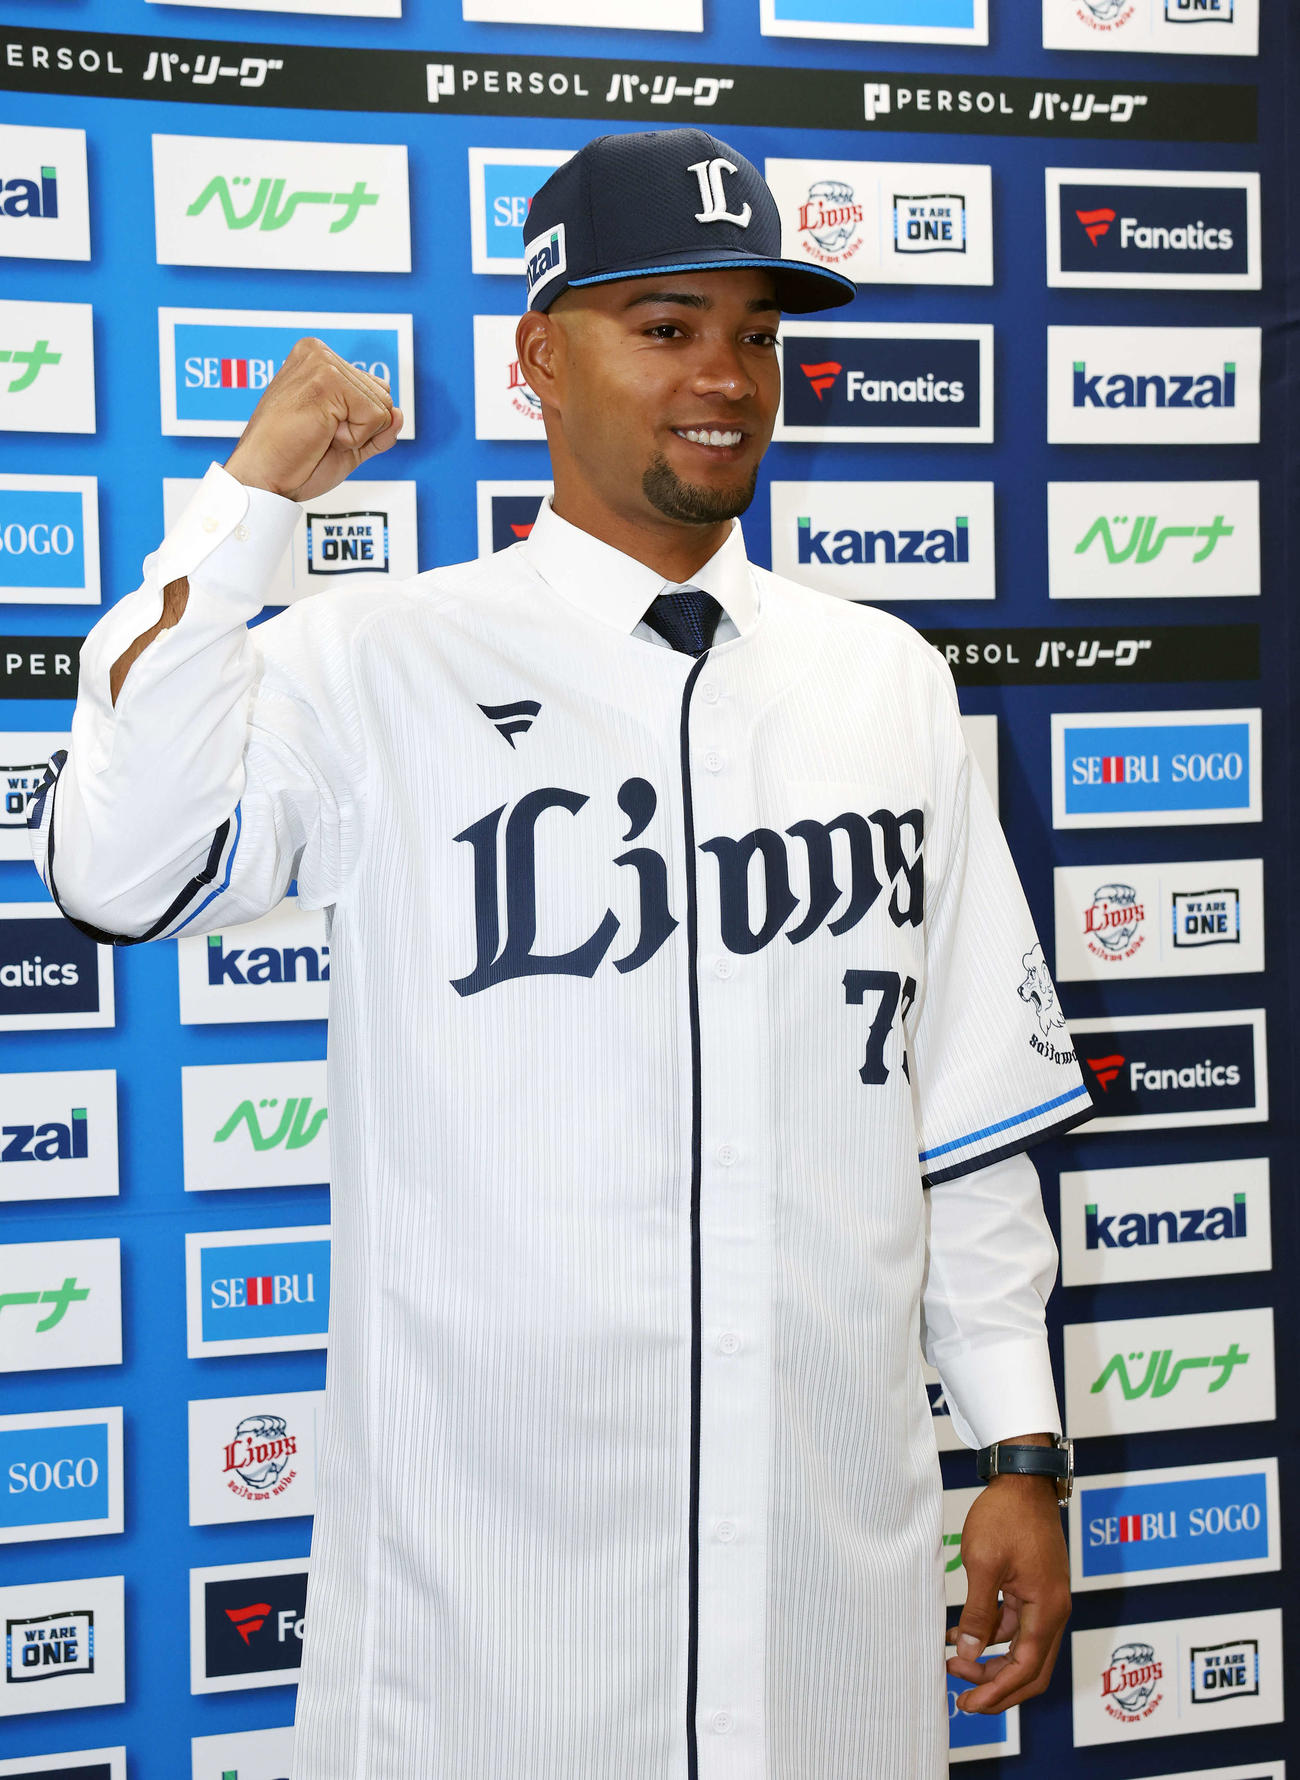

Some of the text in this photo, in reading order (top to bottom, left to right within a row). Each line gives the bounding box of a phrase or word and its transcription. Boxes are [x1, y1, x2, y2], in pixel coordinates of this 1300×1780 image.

[462, 69, 589, 96] PERSOL
[897, 88, 1014, 114] PERSOL
[186, 175, 379, 233] ベルーナ
[687, 157, 752, 228] L
[797, 200, 864, 233] Lions
[908, 208, 951, 217] WE ARE
[907, 220, 953, 241] ONE
[1120, 217, 1234, 250] Fanatics
[847, 371, 965, 403] Fanatics
[1073, 361, 1236, 409] kanzai
[0, 523, 74, 555] OGO
[324, 526, 372, 537] WE ARE
[797, 516, 969, 565] kanzai
[1074, 515, 1235, 564] ベルーナ
[322, 539, 374, 561] ONE
[934, 644, 1019, 664] RSOL
[7, 778, 28, 789] WE
[1072, 753, 1243, 785] SEIBU SOGO
[449, 777, 925, 998] Lions
[1084, 903, 1145, 935] Lions
[1187, 902, 1226, 913] WE ARE
[1185, 914, 1228, 935] ONE
[1130, 1059, 1240, 1091] Fanatics
[1084, 1192, 1247, 1250] kanzai
[211, 1273, 314, 1309] SEIBU
[1090, 1343, 1249, 1401] ベルーナ
[222, 1435, 297, 1473] Lions
[9, 1458, 99, 1494] SOGO
[1090, 1504, 1260, 1546] SEIBU SOGO
[24, 1625, 78, 1642] WE ARE
[22, 1639, 79, 1667] ONE
[1204, 1653, 1246, 1667] WE ARE
[1101, 1661, 1163, 1698] Lions
[1203, 1664, 1247, 1690] ONE
